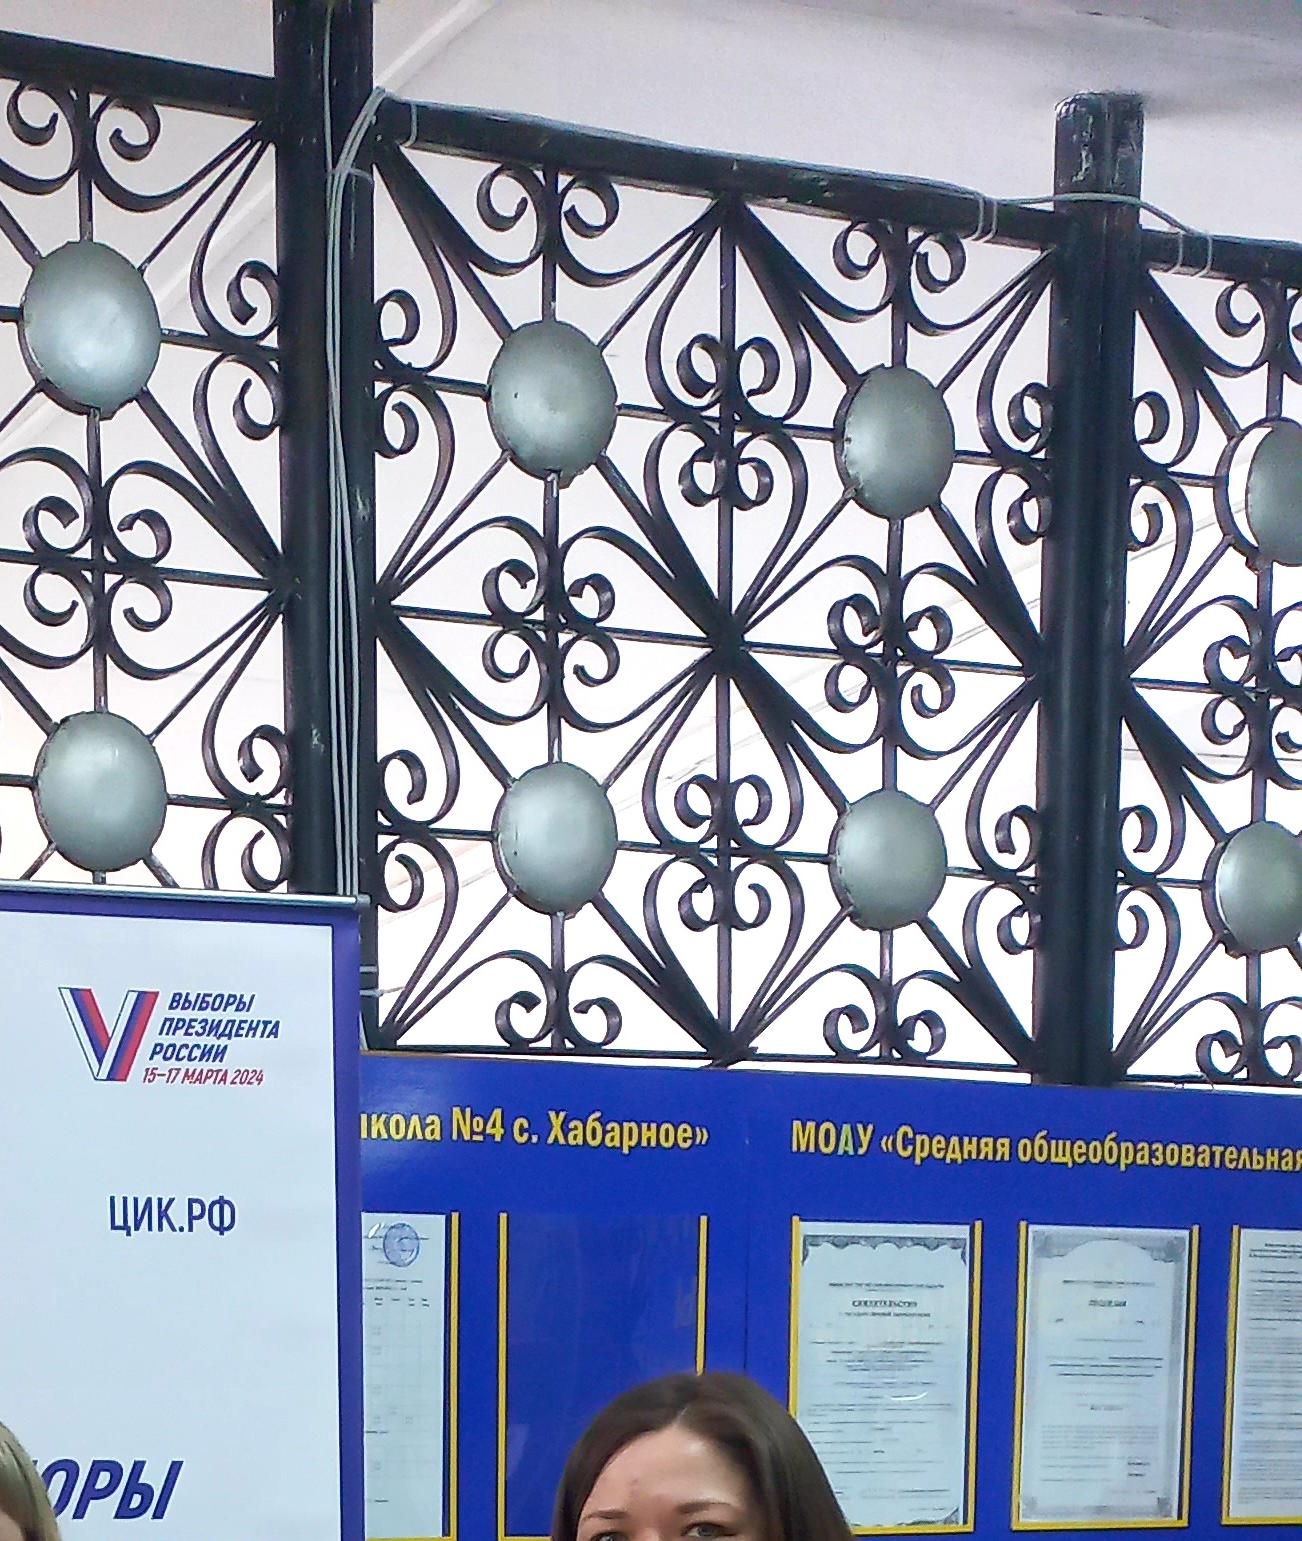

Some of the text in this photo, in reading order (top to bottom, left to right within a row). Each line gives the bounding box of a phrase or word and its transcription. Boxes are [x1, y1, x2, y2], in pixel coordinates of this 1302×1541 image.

[168, 992, 255, 1013] ВЫБОРЫ
[158, 1017, 280, 1040] ПРЕЗИДЕНТА
[149, 1042, 228, 1063] РОССИИ
[182, 1068, 227, 1085] МАРТА
[230, 1069, 264, 1086] 2024
[360, 1107, 709, 1155] кола №4 с. Хабарное»
[791, 1119, 874, 1156] МОАУ
[880, 1123, 1011, 1165] «Средняя
[110, 1195, 236, 1237] ЦИК.РФ
